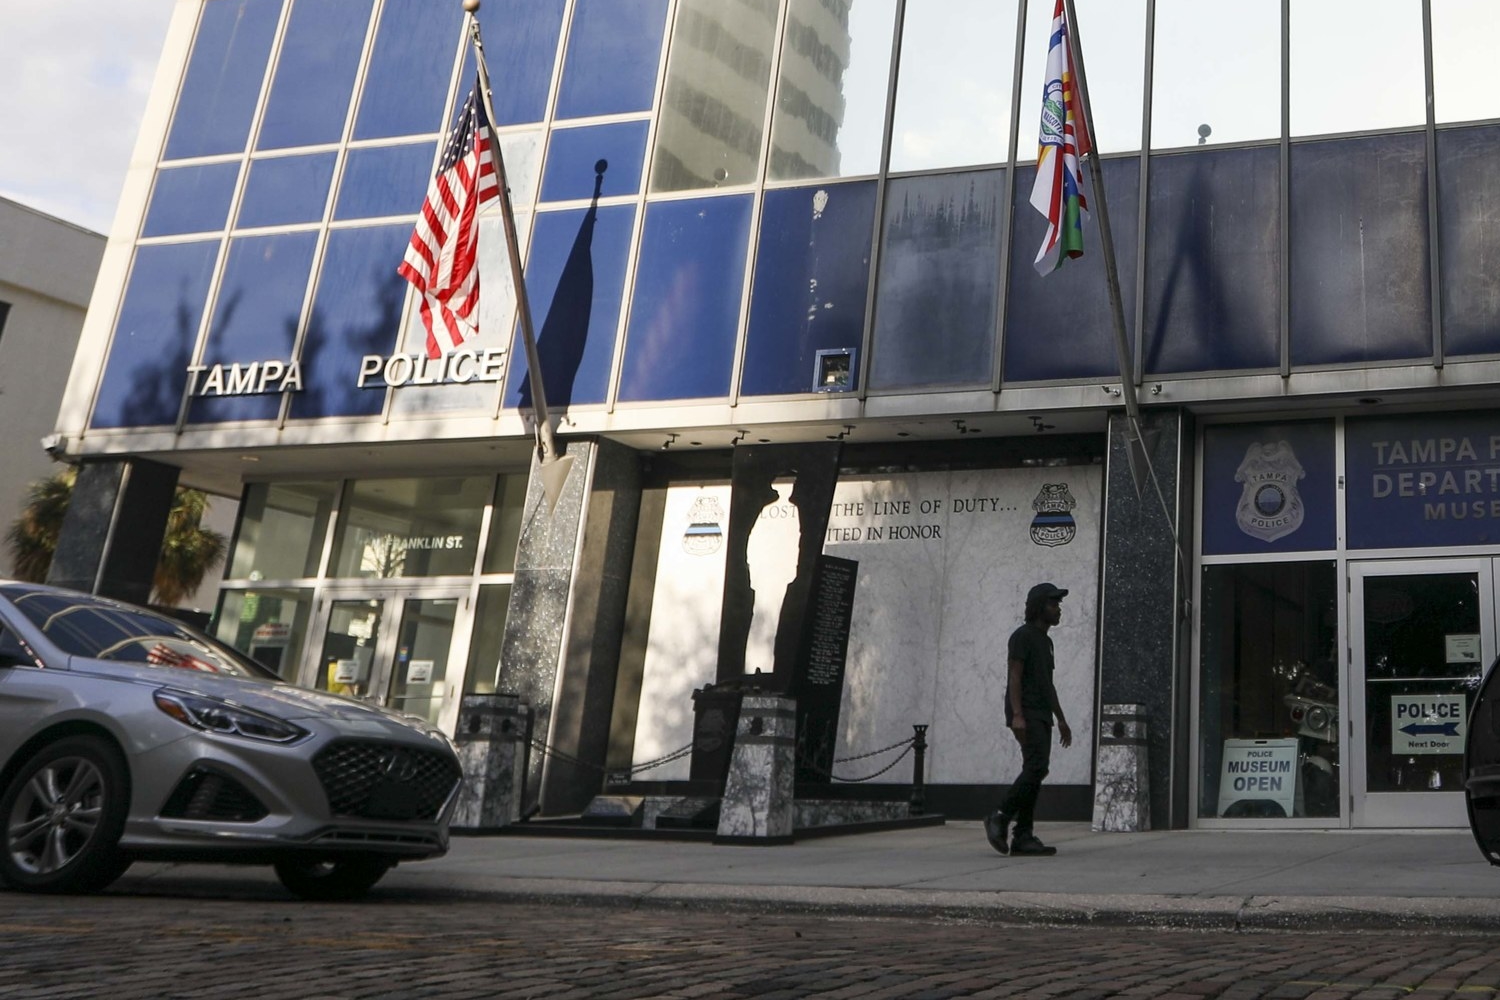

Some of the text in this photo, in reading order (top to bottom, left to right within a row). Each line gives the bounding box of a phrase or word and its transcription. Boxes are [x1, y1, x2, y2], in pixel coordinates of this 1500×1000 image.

[187, 347, 508, 396] TAMPA POLICE
[1372, 437, 1479, 465] TAMPA
[1252, 472, 1288, 481] TAMPA
[760, 498, 1017, 519] LOST THE LINE OF DUTY...
[1043, 503, 1066, 511] TAMPA
[1251, 517, 1289, 528] POLICE
[867, 527, 883, 540] IN
[889, 525, 942, 540] HONOR
[446, 535, 463, 549] ST.
[1397, 702, 1460, 719] POLICE
[1430, 740, 1450, 748] Door
[1228, 761, 1291, 773] MUSEUM
[1233, 777, 1282, 791] OPEN
